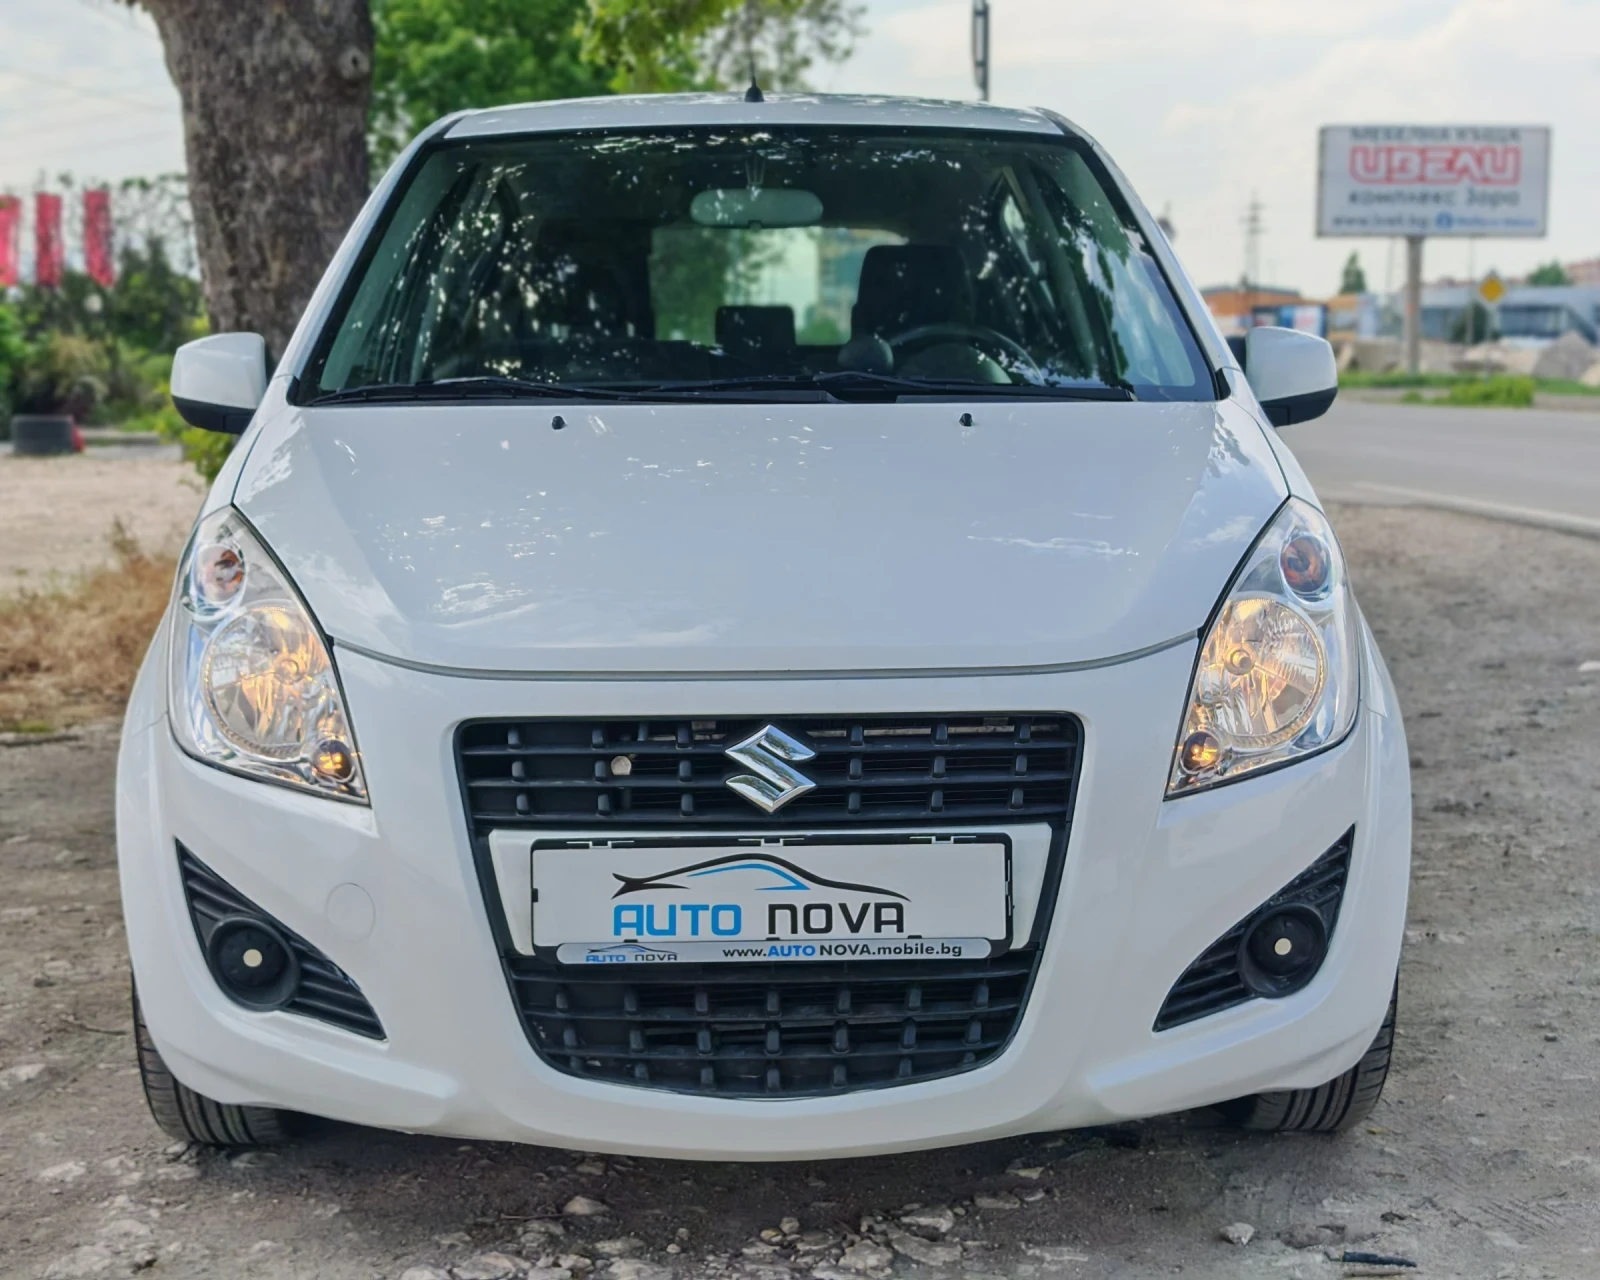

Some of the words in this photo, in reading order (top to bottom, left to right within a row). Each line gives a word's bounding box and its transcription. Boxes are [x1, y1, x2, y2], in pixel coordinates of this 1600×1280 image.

[613, 904, 742, 936] AUTO
[768, 902, 904, 934] NOVA
[585, 954, 626, 963] AUTO
[634, 954, 678, 962] NOVA
